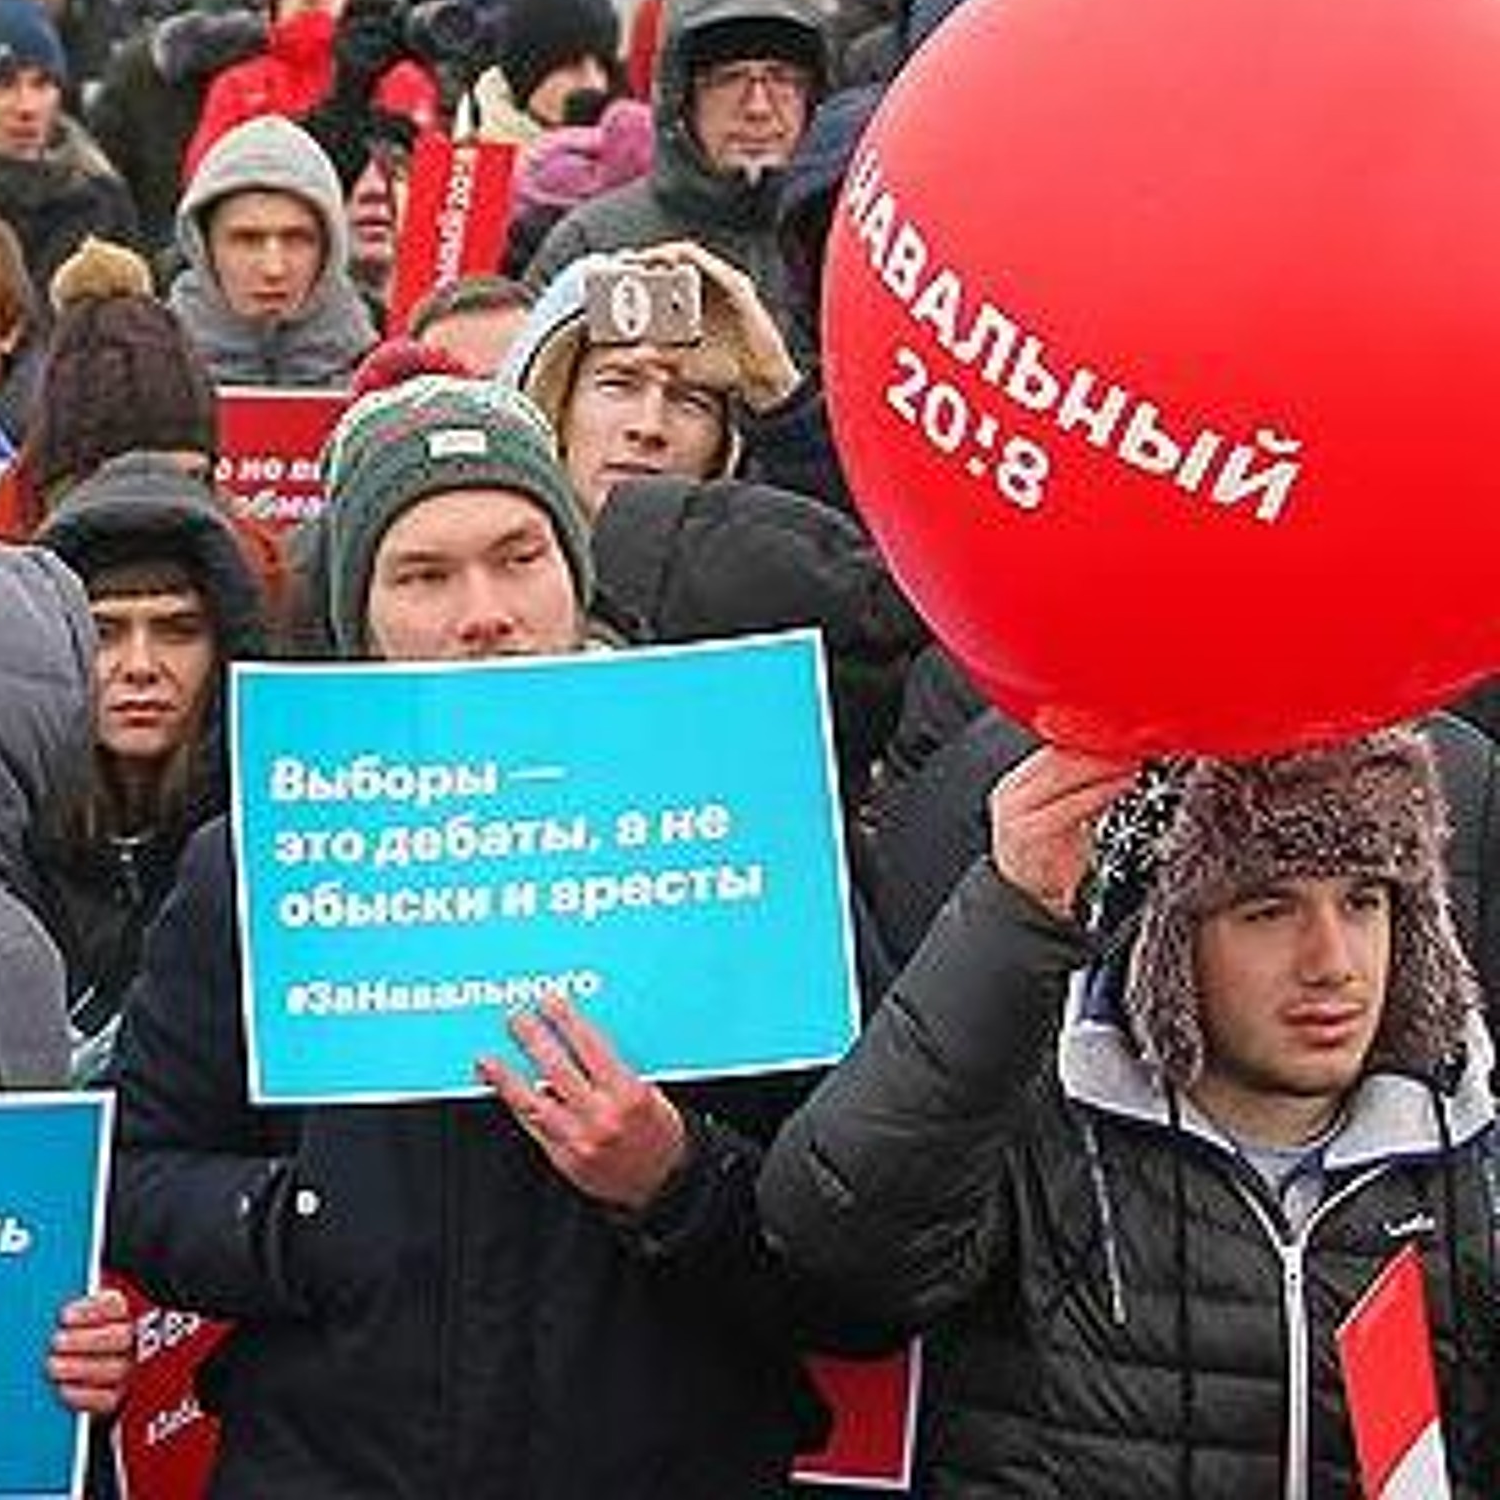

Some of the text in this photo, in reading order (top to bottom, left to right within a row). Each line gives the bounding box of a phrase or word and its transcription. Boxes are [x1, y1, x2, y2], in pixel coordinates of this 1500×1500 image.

[269, 755, 498, 806] Выборы
[275, 802, 731, 867] это дебаты, а не
[279, 863, 764, 928] обыски и аресты
